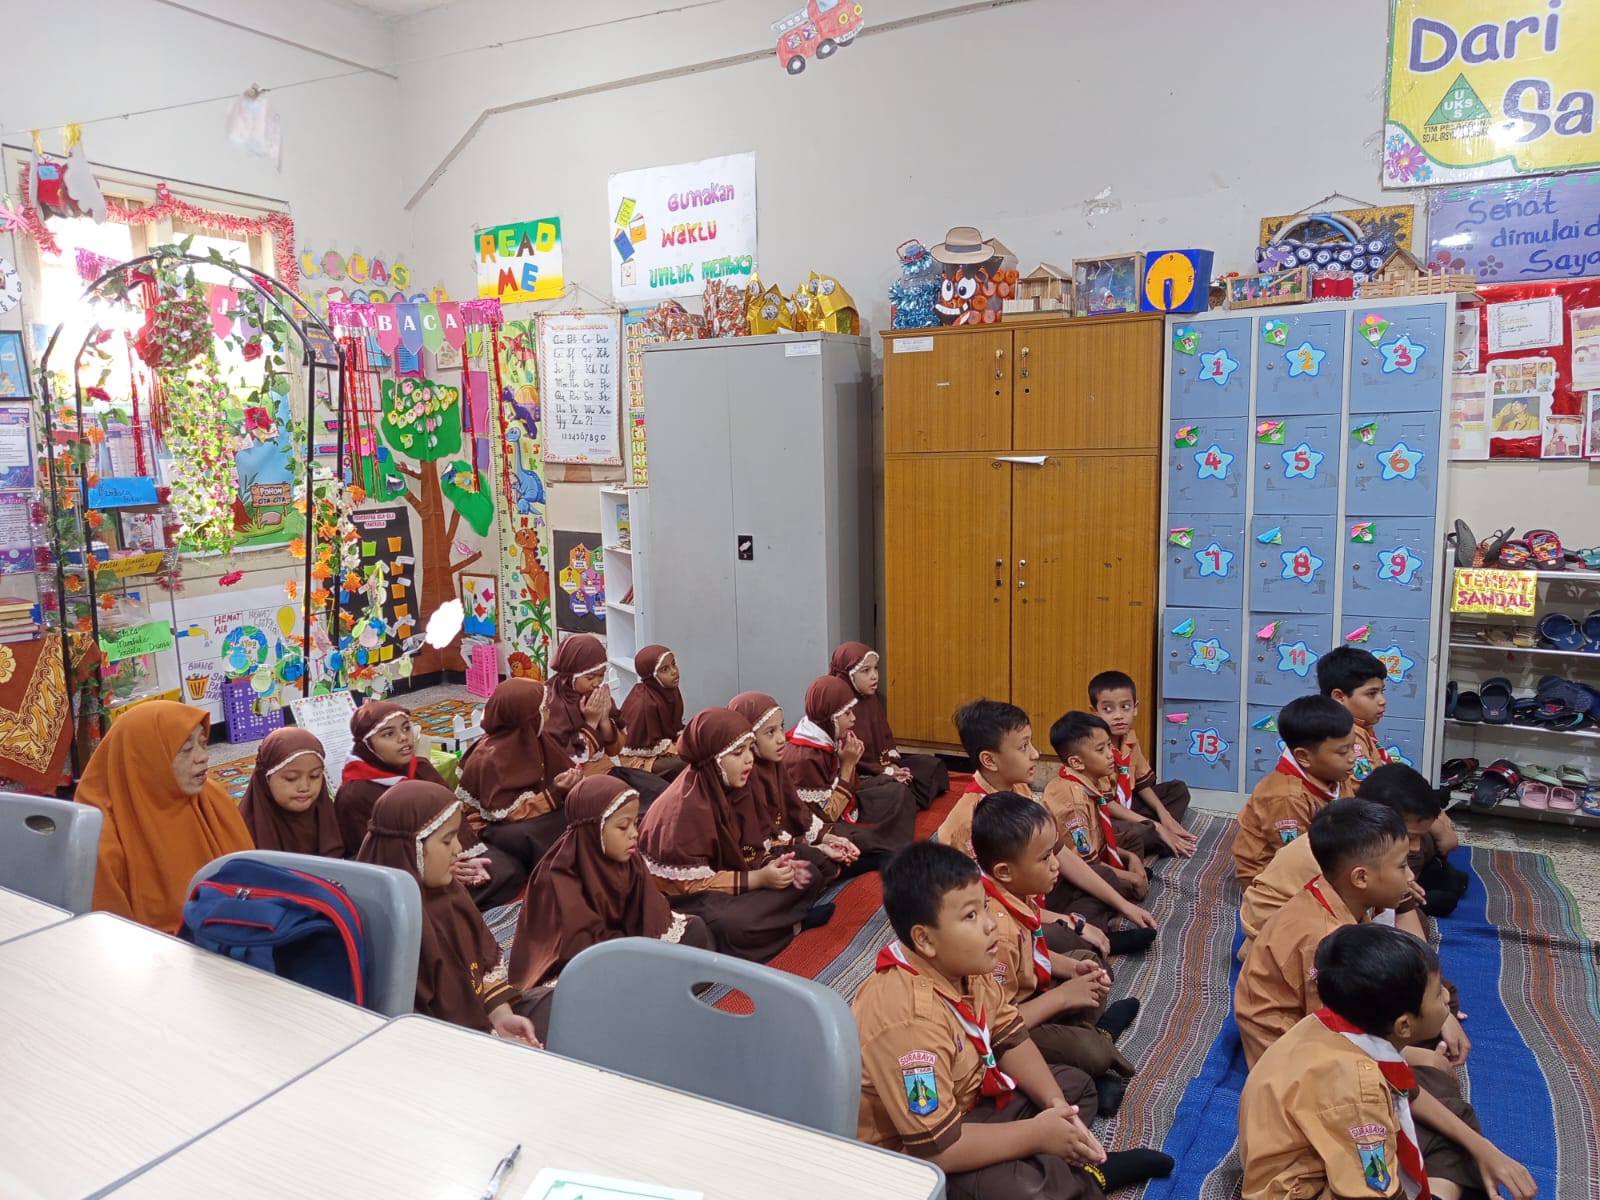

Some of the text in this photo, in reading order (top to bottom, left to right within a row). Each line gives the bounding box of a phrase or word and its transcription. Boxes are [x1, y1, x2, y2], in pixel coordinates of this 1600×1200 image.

[1409, 0, 1562, 72] Dari
[1443, 98, 1474, 111] UKS
[1502, 79, 1594, 143] Sa
[480, 222, 557, 263] READ
[1490, 219, 1580, 248] dimulai
[301, 251, 407, 286] KELAS
[1520, 249, 1600, 275] Saya
[498, 262, 539, 295] ME
[1296, 349, 1315, 371] 2
[1392, 343, 1412, 367] 3
[1211, 357, 1224, 377] 1
[1204, 452, 1222, 471] 4
[1294, 451, 1311, 471] 5
[1389, 449, 1410, 472] 6
[259, 486, 283, 496] POHON
[1204, 549, 1220, 571] 7
[1293, 552, 1311, 577] 8
[1390, 551, 1407, 577] 9
[1457, 590, 1532, 608] SANDAL
[214, 612, 242, 626] HEMAT
[215, 625, 228, 635] AIR
[1200, 645, 1216, 660] 10
[1288, 649, 1306, 666] 11
[1196, 733, 1219, 755] 13
[900, 1052, 935, 1066] SURABAYA
[1351, 1125, 1386, 1137] SURABAYA
